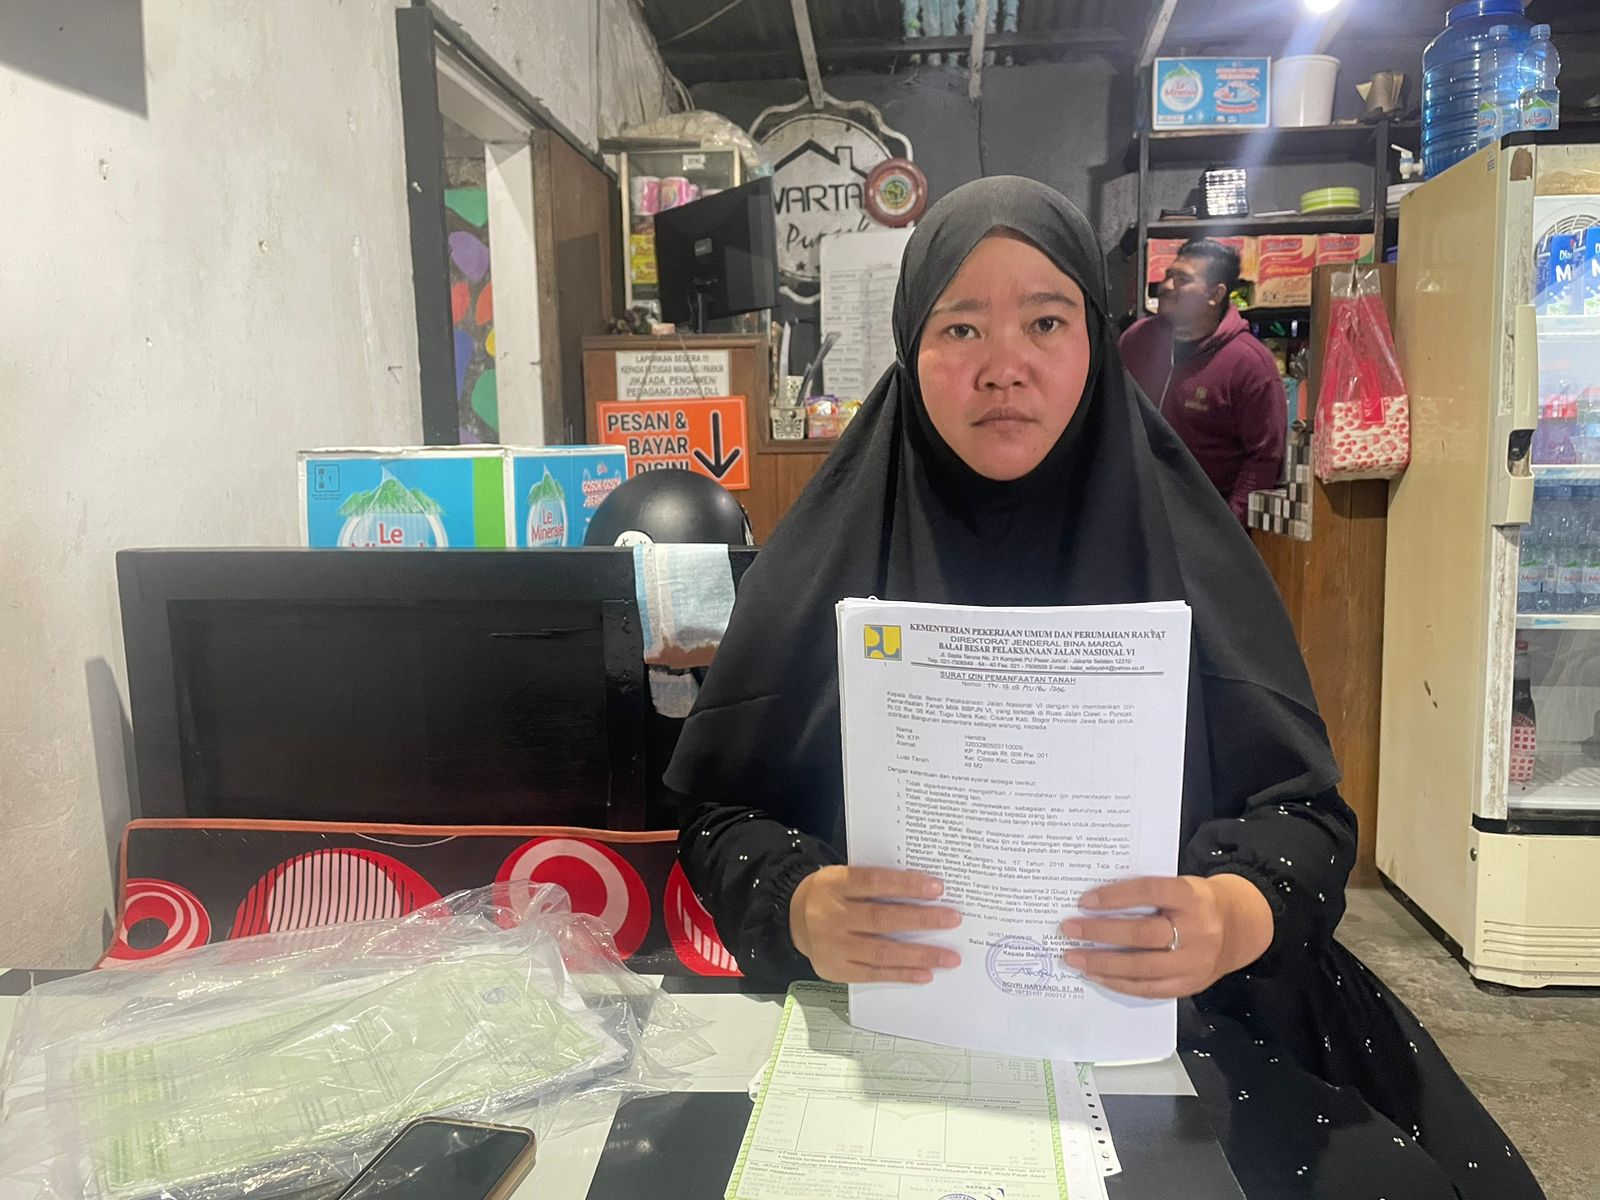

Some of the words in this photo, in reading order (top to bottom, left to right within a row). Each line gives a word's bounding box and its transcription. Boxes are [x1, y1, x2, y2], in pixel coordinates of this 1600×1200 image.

[630, 377, 647, 385] JIKA
[626, 388, 672, 397] PEDAGANG
[608, 412, 669, 431] PESAN
[675, 412, 686, 429] &
[629, 437, 688, 455] BAYAR
[542, 509, 552, 524] Le
[379, 523, 403, 544] Le
[910, 623, 970, 634] KEMENTERIAN
[972, 628, 1022, 637] PEKERJAAN
[951, 636, 1008, 645] DIREKTORAT
[939, 643, 963, 651] BALAI
[965, 644, 990, 652] BESAR
[992, 646, 1052, 655] PELAKSANAAN
[985, 674, 1045, 682] PEMANFAATAN
[1046, 702, 1069, 710] dengan
[1032, 716, 1050, 724] Bogor
[910, 770, 937, 778] ketentuan
